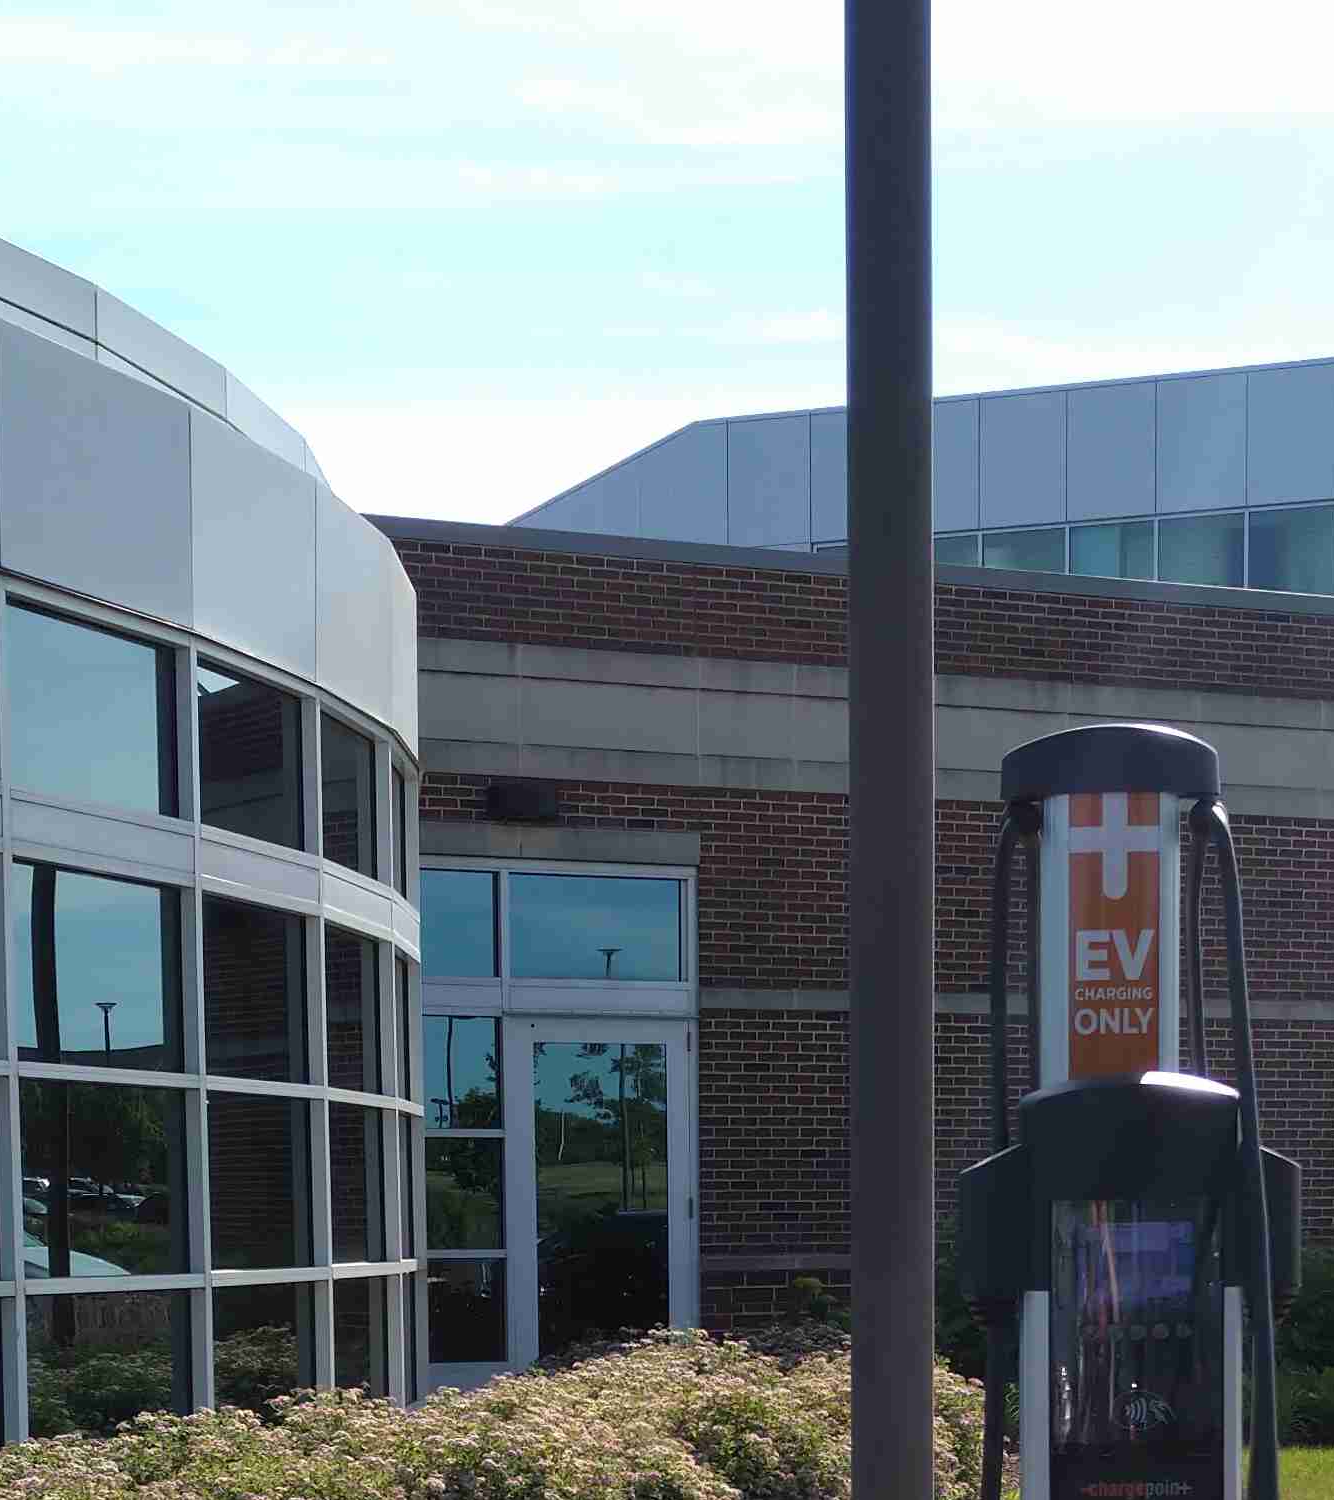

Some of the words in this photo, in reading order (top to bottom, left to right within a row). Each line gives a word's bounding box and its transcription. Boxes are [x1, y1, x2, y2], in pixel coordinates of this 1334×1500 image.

[1075, 929, 1154, 981] EV
[1075, 987, 1152, 1000] CHARGING
[1074, 1008, 1154, 1034] ONLY
